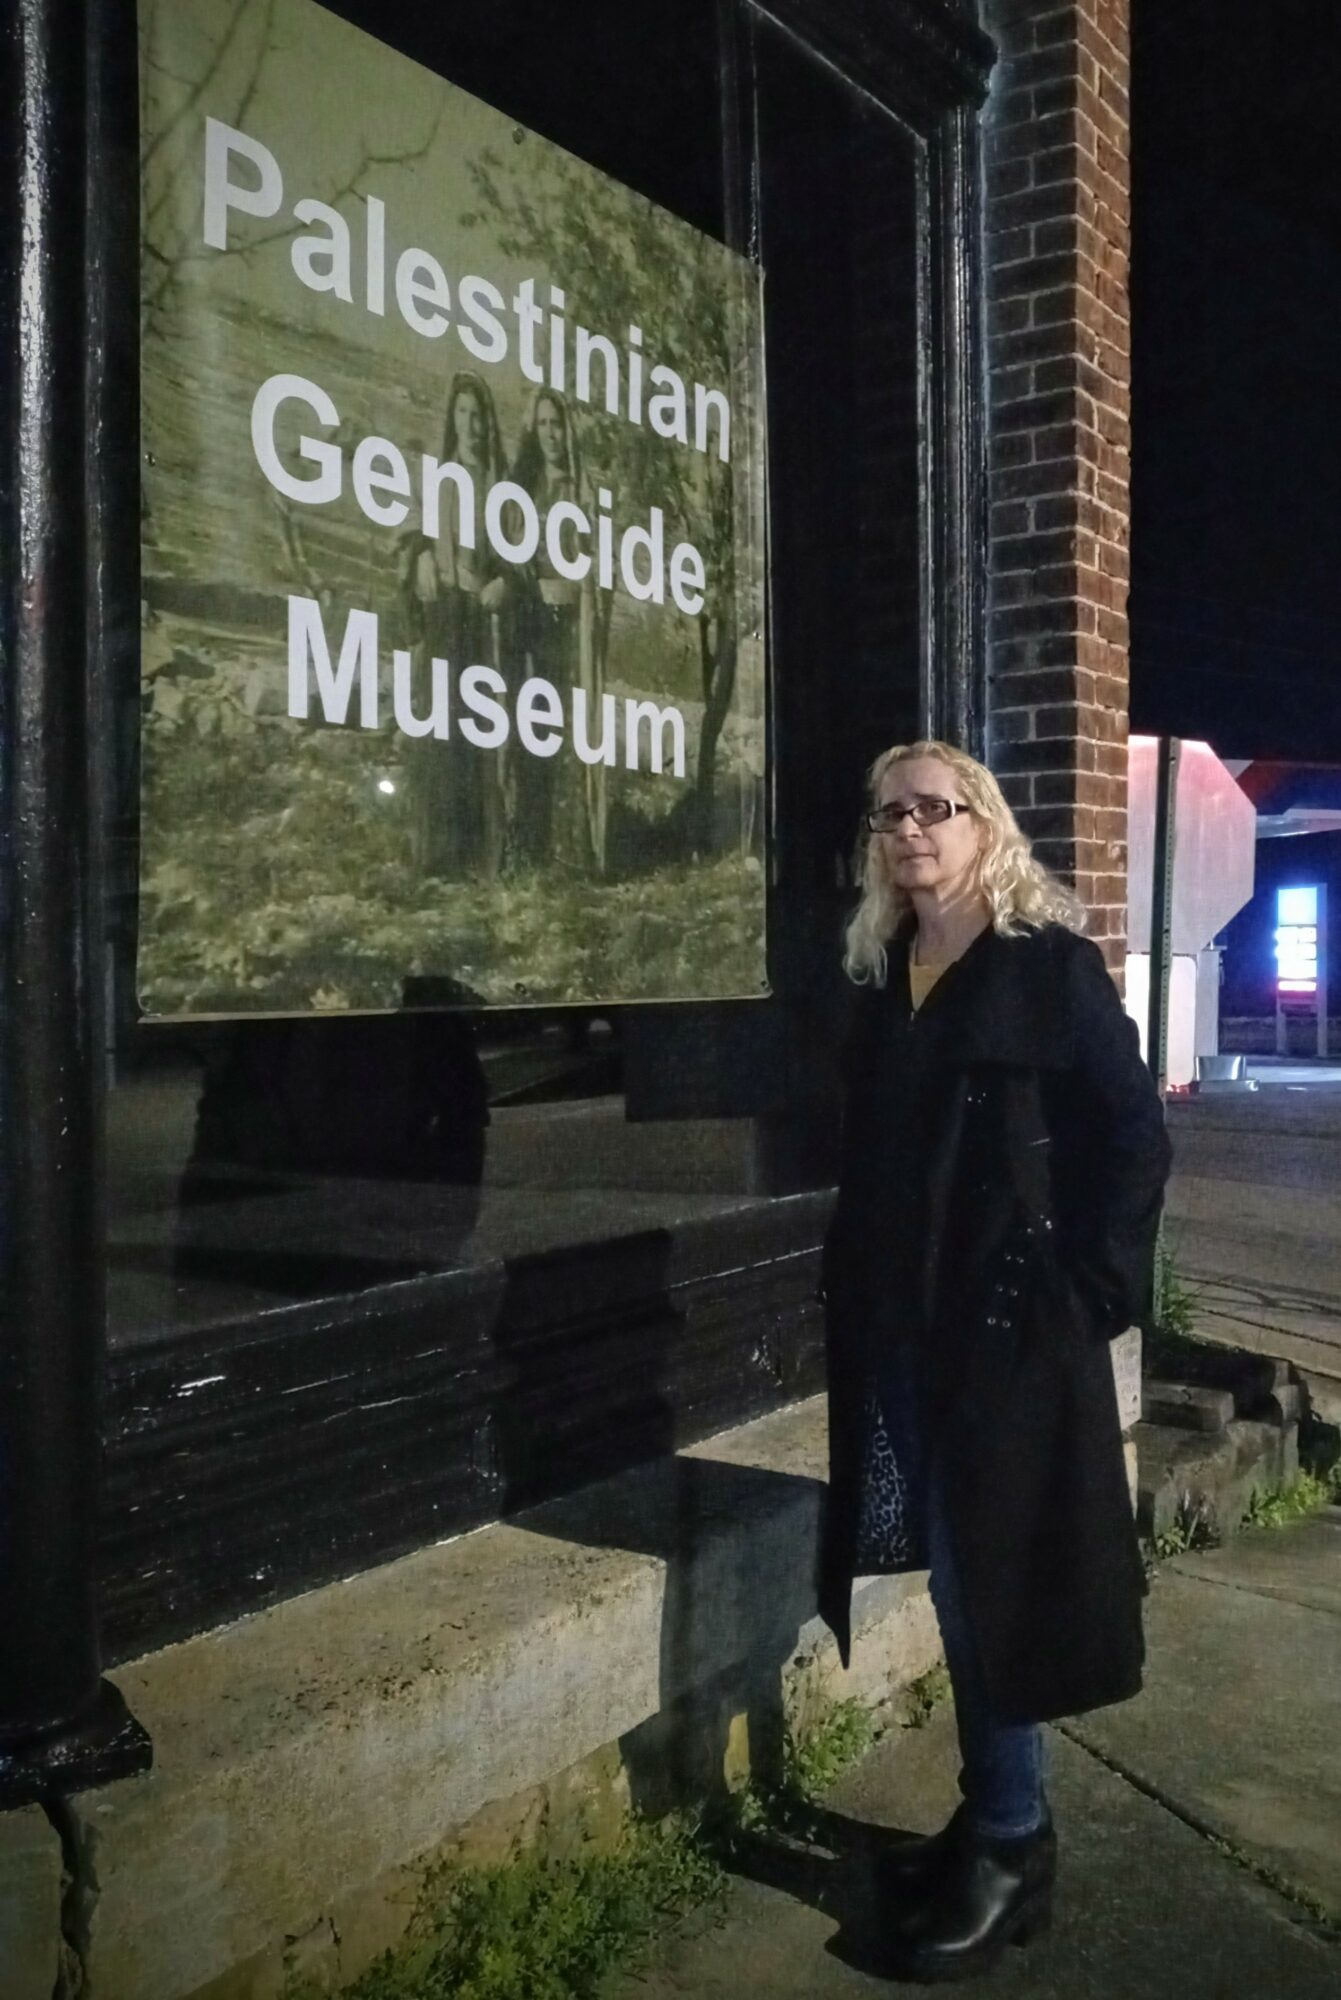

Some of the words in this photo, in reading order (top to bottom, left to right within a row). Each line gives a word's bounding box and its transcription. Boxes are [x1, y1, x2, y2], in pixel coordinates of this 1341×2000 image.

[203, 116, 731, 463] Palestinian
[251, 373, 705, 616] Genocide
[287, 595, 686, 779] Museum
